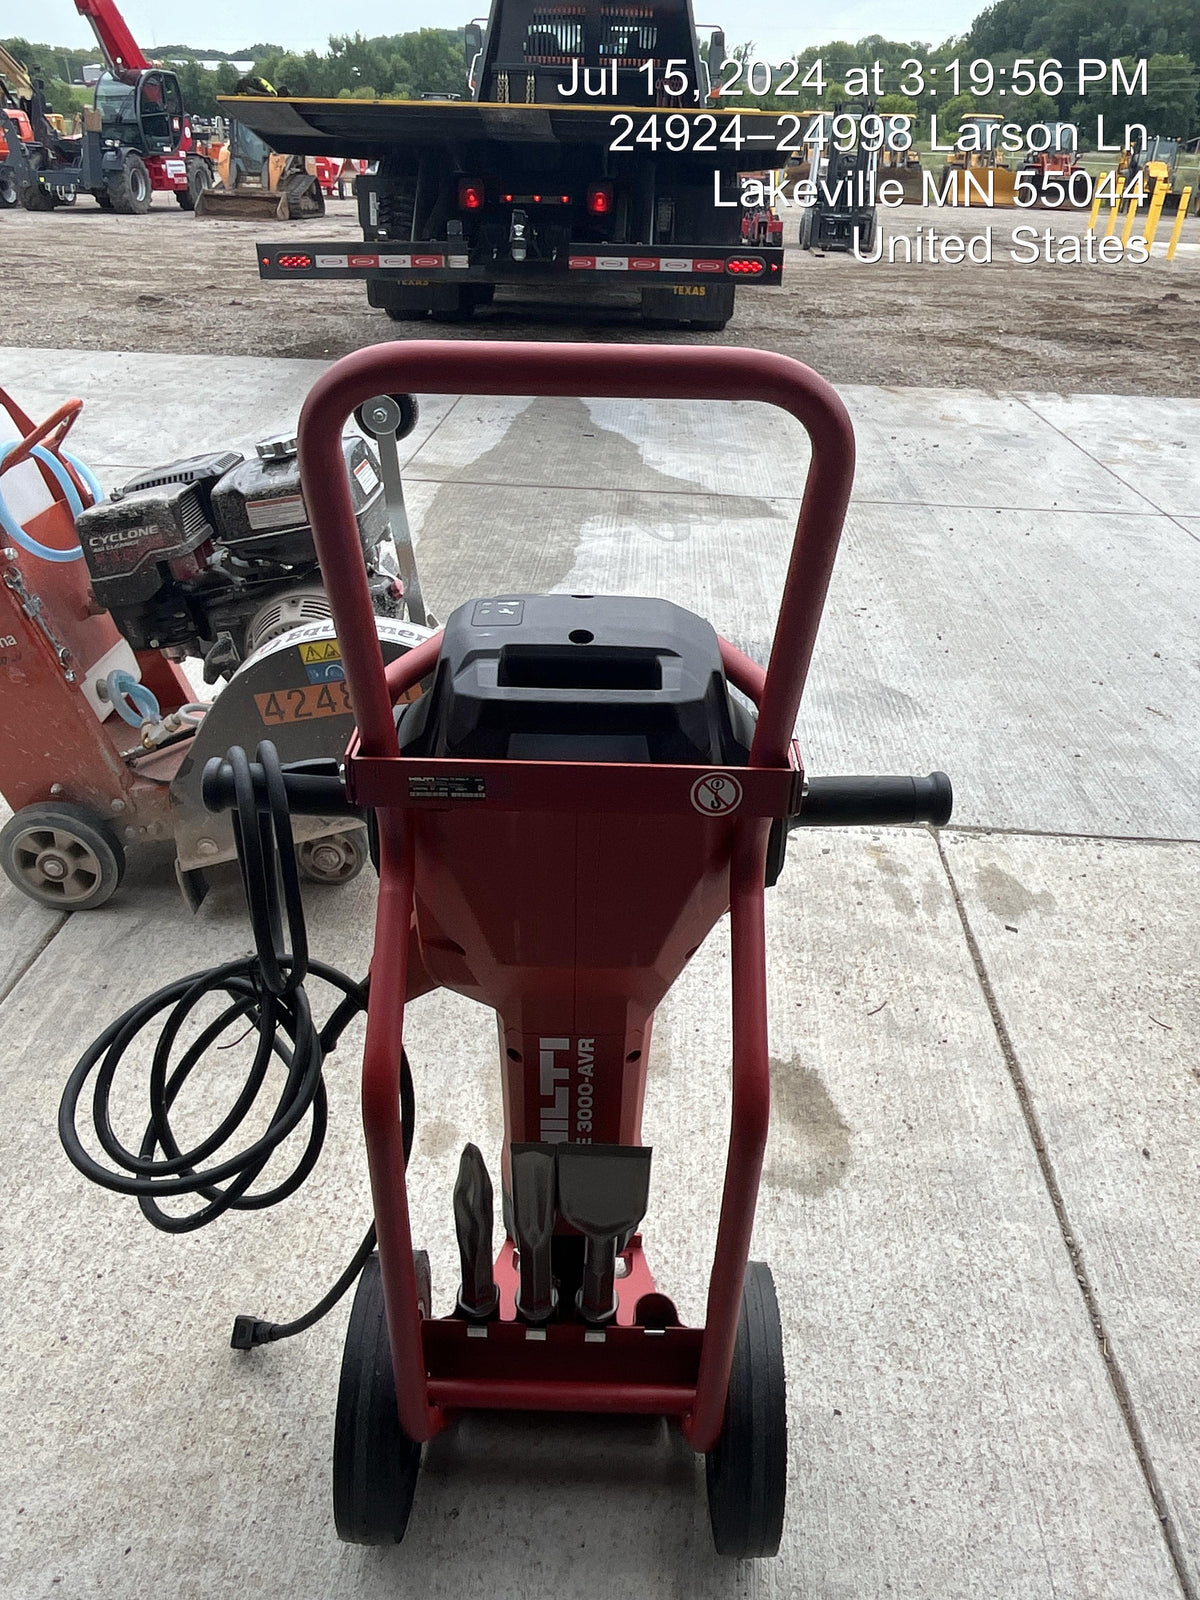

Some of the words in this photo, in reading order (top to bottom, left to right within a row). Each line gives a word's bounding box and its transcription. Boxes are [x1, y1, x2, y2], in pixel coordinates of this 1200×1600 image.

[673, 285, 706, 296] TEXAS
[89, 525, 159, 546] CYCLONE
[577, 1039, 596, 1133] 3000-AVR
